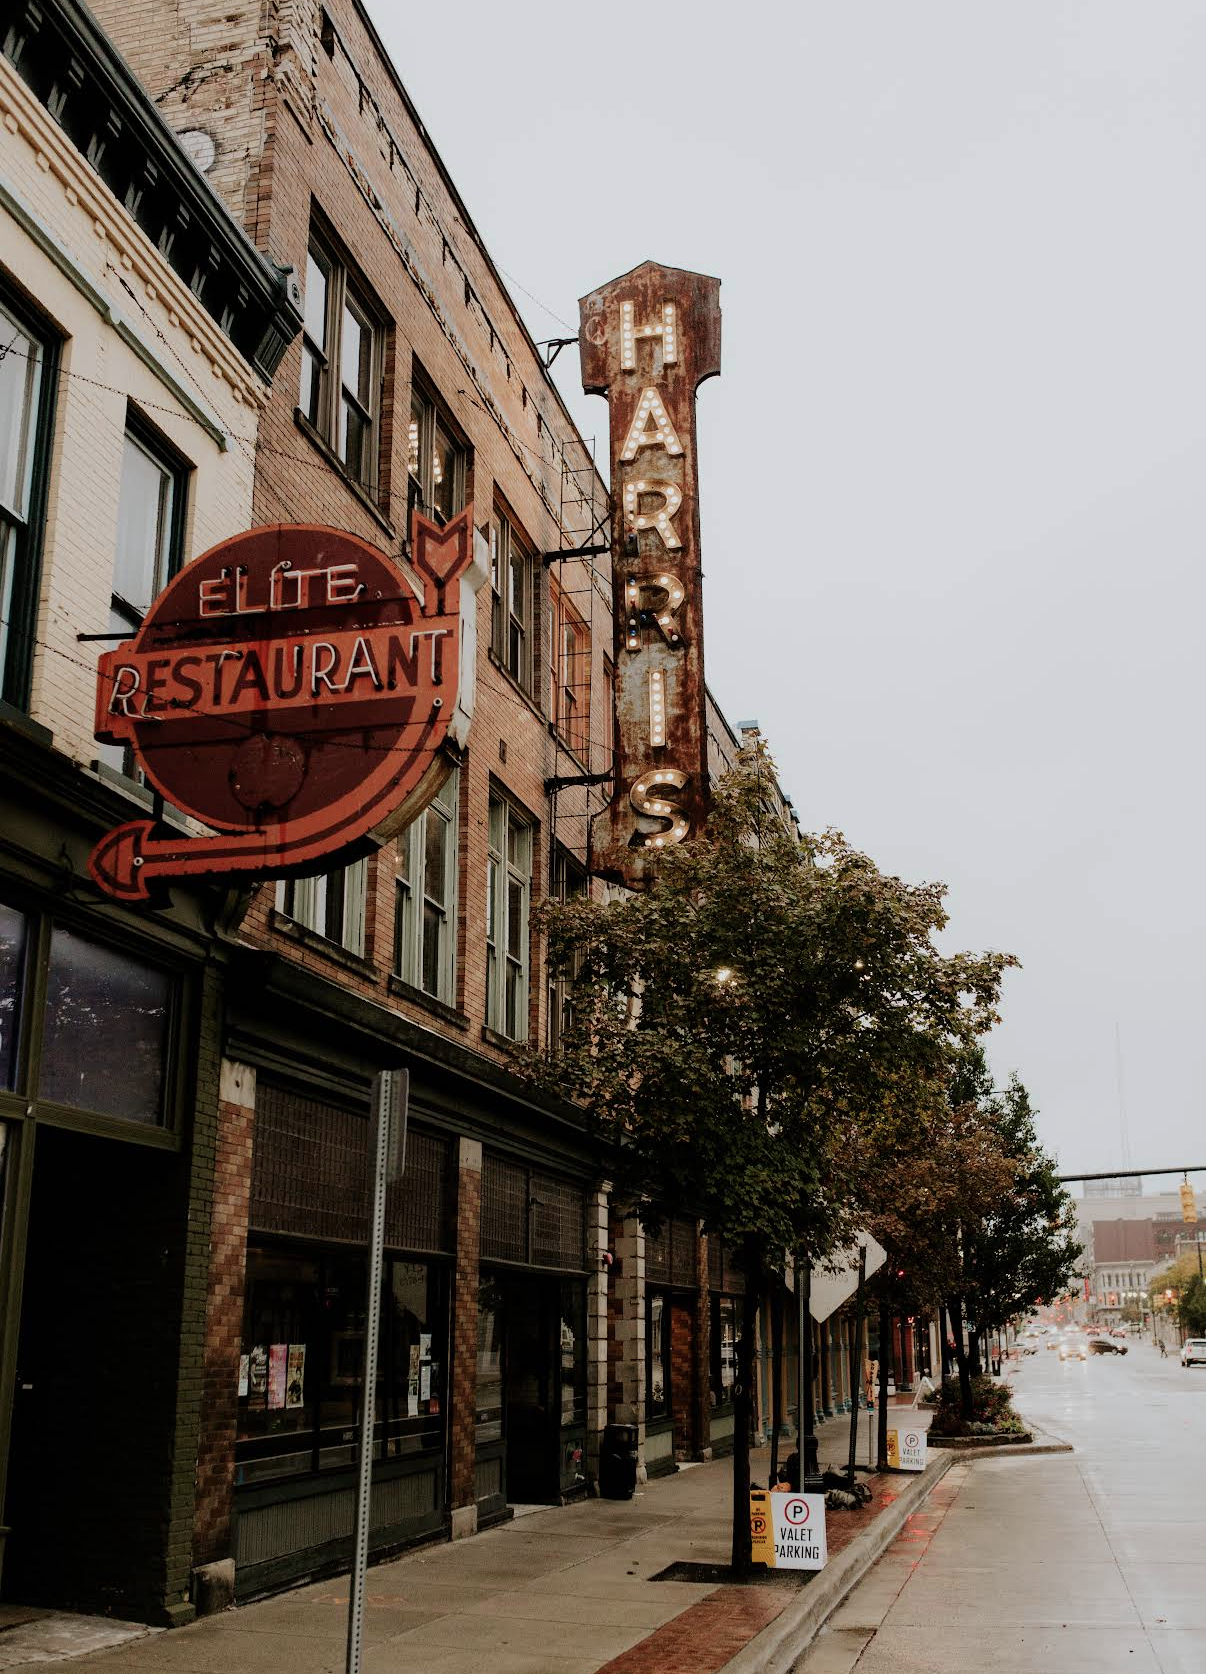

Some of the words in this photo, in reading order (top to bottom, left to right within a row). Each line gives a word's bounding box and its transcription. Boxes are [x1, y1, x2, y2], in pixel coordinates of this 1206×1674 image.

[620, 300, 690, 847] HARRIS
[200, 561, 367, 617] ELITE
[109, 629, 454, 721] RESTAURANT
[909, 1437, 916, 1445] P
[902, 1447, 921, 1457] VALET
[793, 1505, 803, 1518] P
[780, 1527, 813, 1542] VALET
[774, 1544, 820, 1560] PARKING
